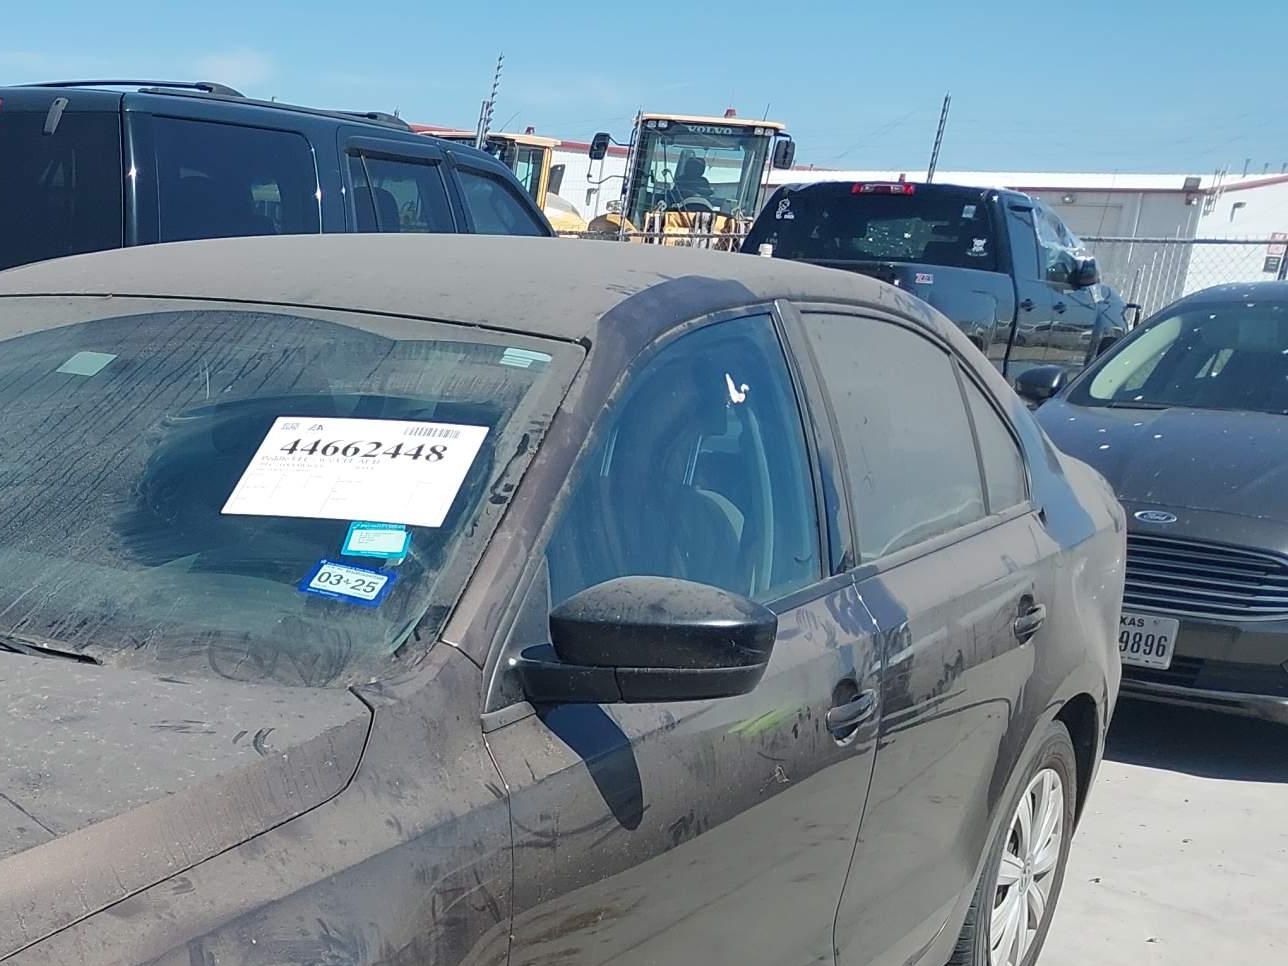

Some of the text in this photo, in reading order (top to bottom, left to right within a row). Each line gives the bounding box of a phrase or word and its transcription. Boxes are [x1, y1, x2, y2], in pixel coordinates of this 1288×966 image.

[687, 125, 733, 135] VOLVO
[280, 438, 448, 463] 44662448
[317, 571, 344, 586] 03
[349, 578, 379, 593] 25
[1119, 630, 1168, 657] 9896
